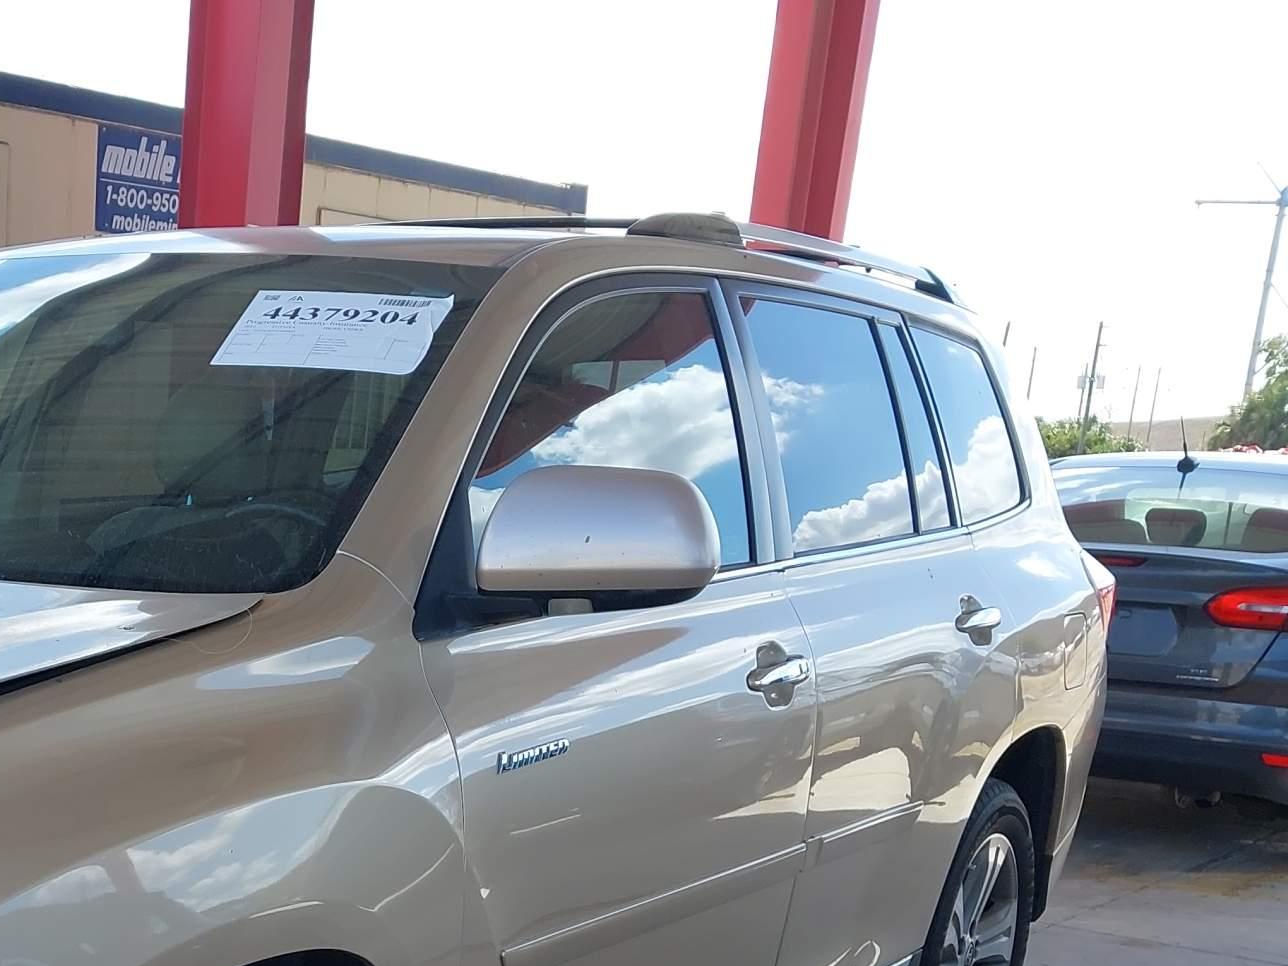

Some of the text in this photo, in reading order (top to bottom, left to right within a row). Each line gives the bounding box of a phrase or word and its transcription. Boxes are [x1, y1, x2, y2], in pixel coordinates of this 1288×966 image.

[101, 136, 176, 183] mobile
[263, 306, 420, 326] 44379204
[497, 738, 569, 774] LIMITED
